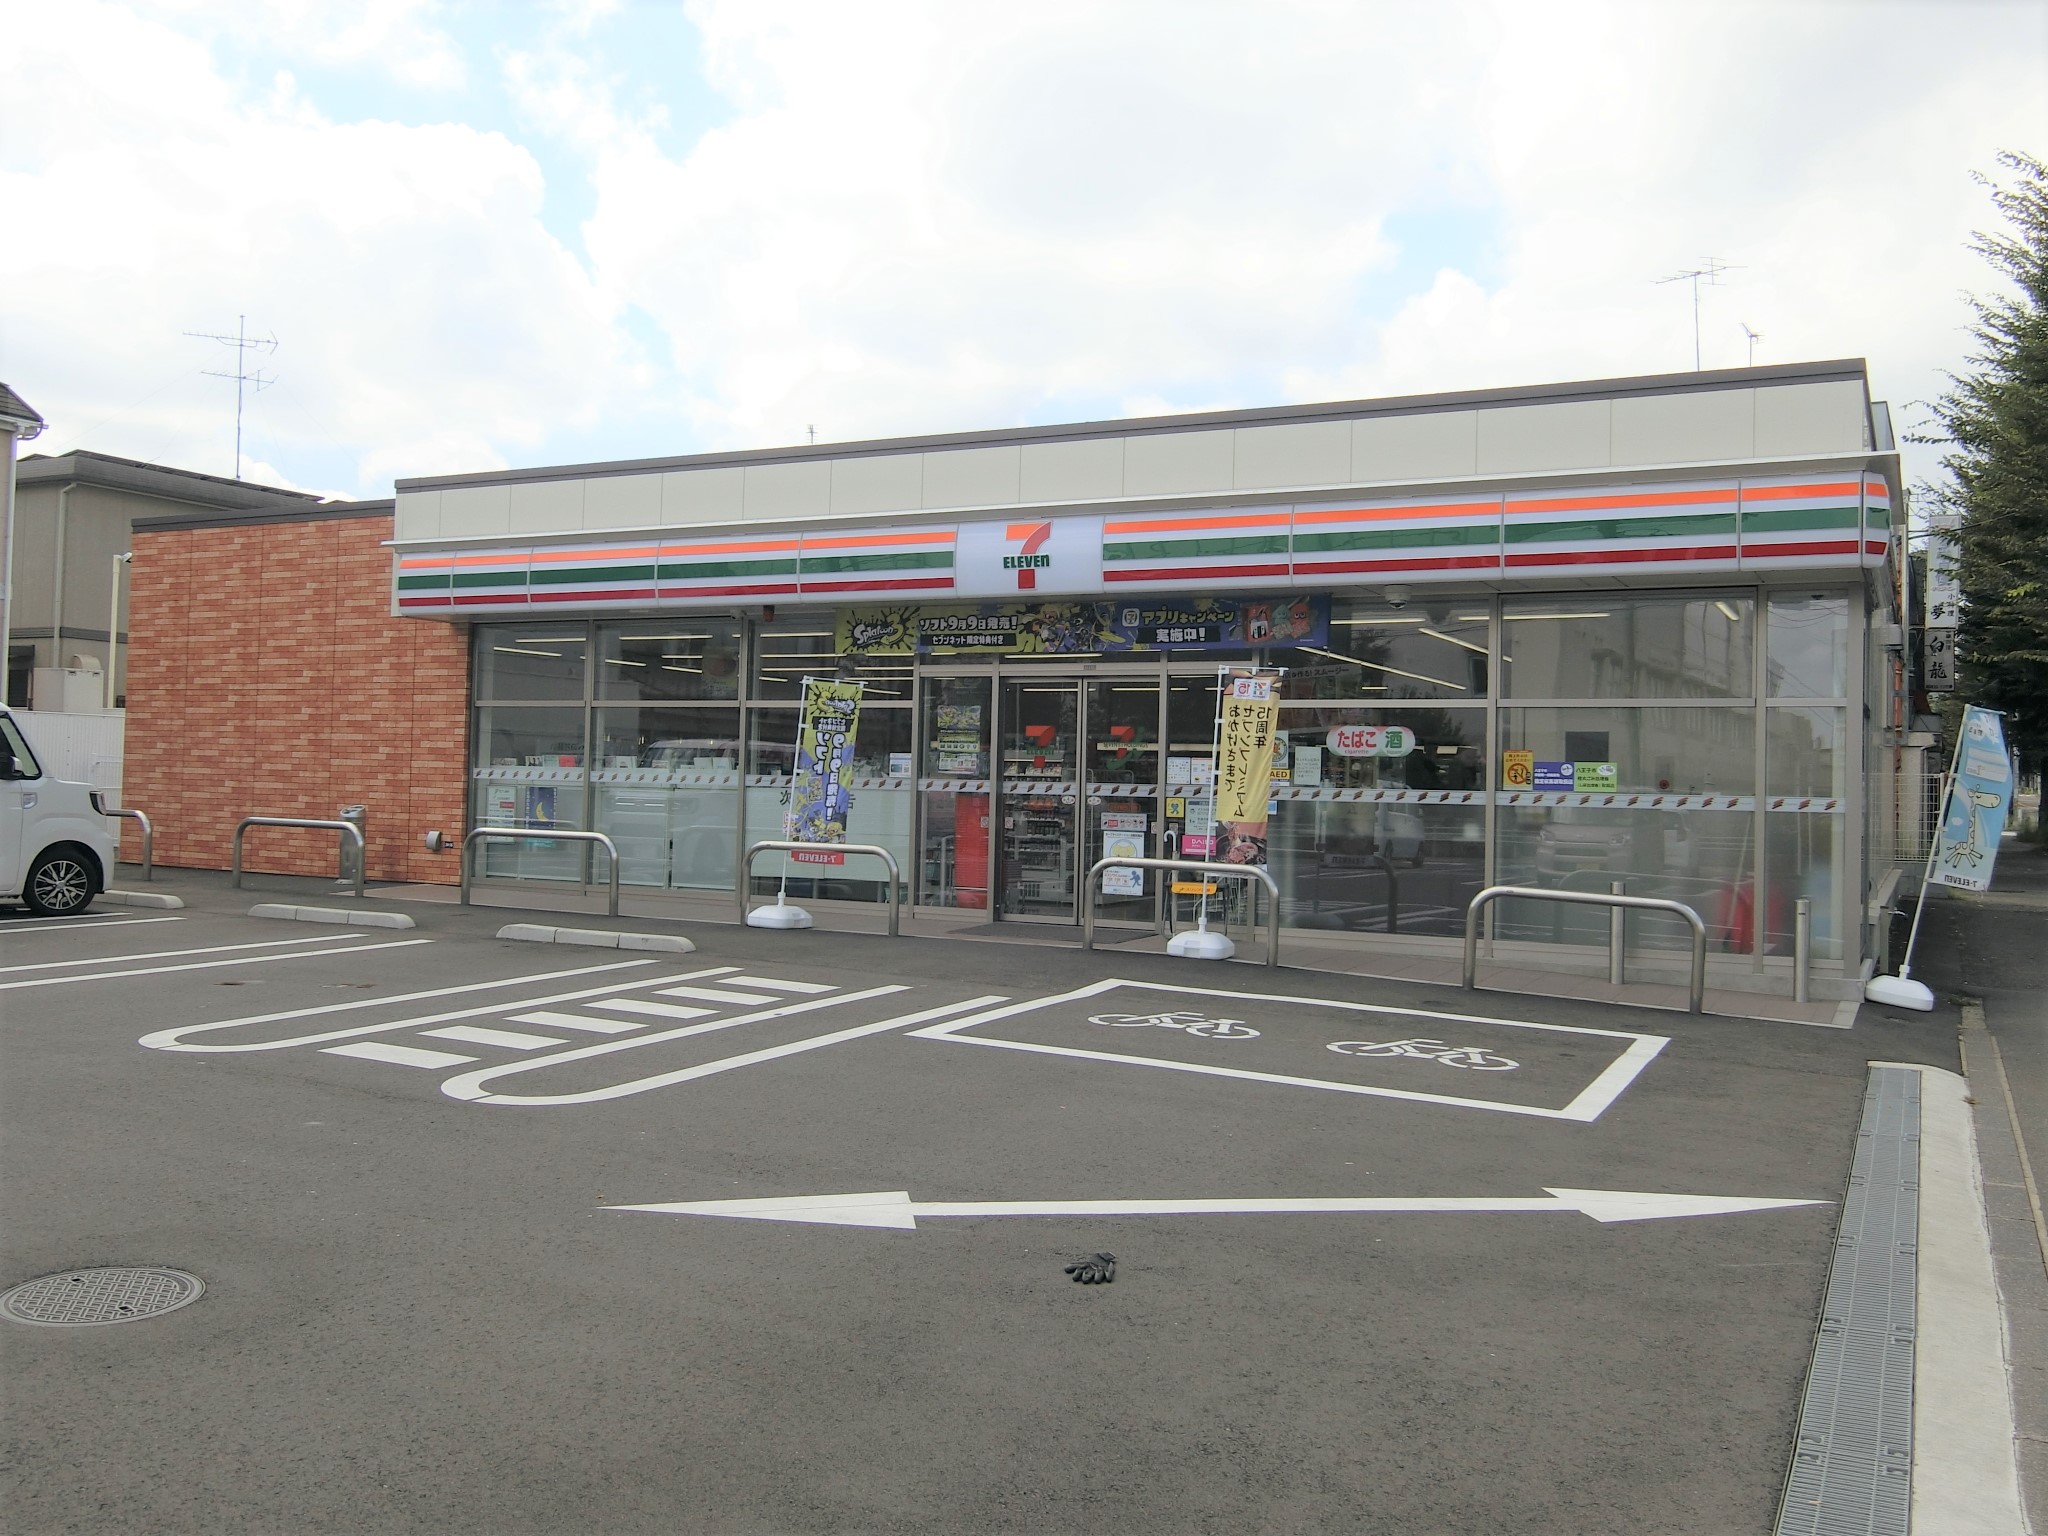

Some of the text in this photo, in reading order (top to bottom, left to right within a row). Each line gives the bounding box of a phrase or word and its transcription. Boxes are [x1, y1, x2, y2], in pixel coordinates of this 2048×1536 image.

[1006, 521, 1051, 589] 7
[1142, 606, 1234, 625] アプリキャンペーン
[1928, 636, 1947, 679] 白龍
[1337, 731, 1403, 748] たばこ 酒
